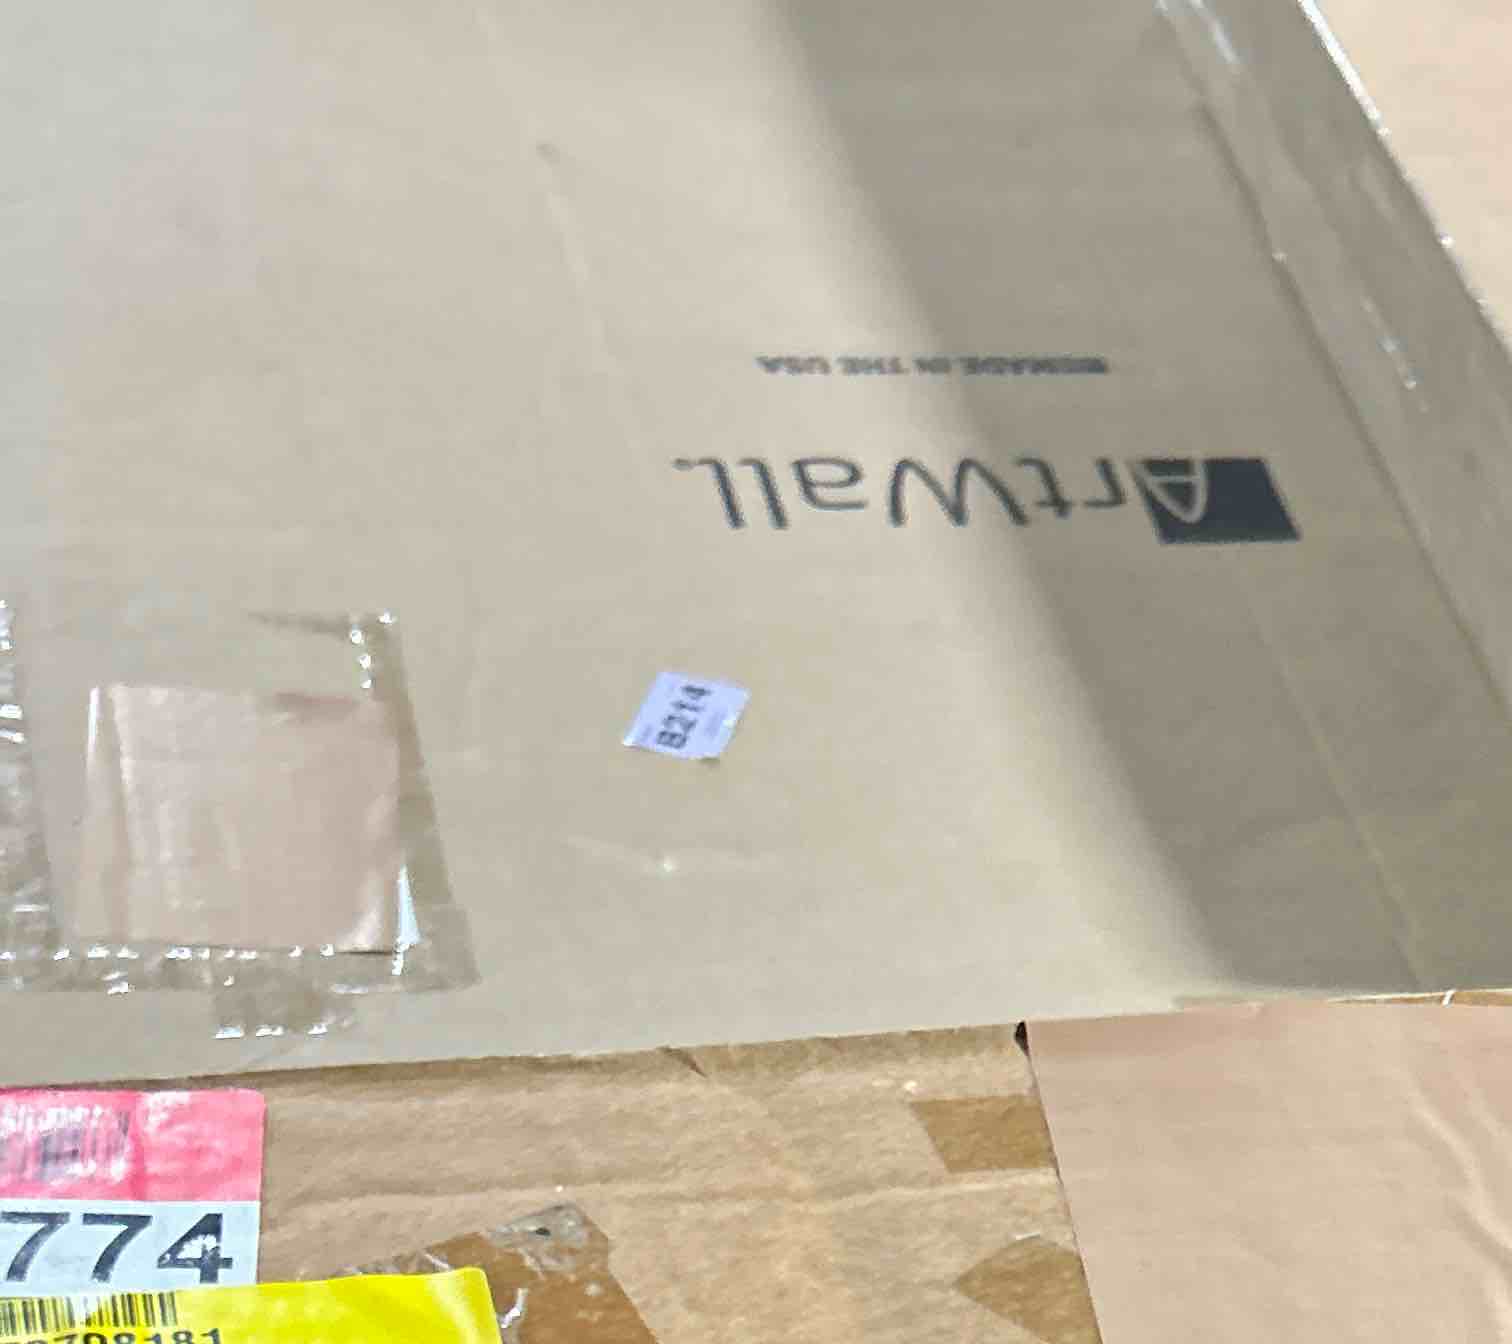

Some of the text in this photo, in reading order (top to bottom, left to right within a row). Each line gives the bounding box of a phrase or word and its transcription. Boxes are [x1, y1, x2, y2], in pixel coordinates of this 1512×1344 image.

[756, 356, 831, 375] USA
[838, 356, 908, 375] THE
[0, 1211, 233, 1284] 774
